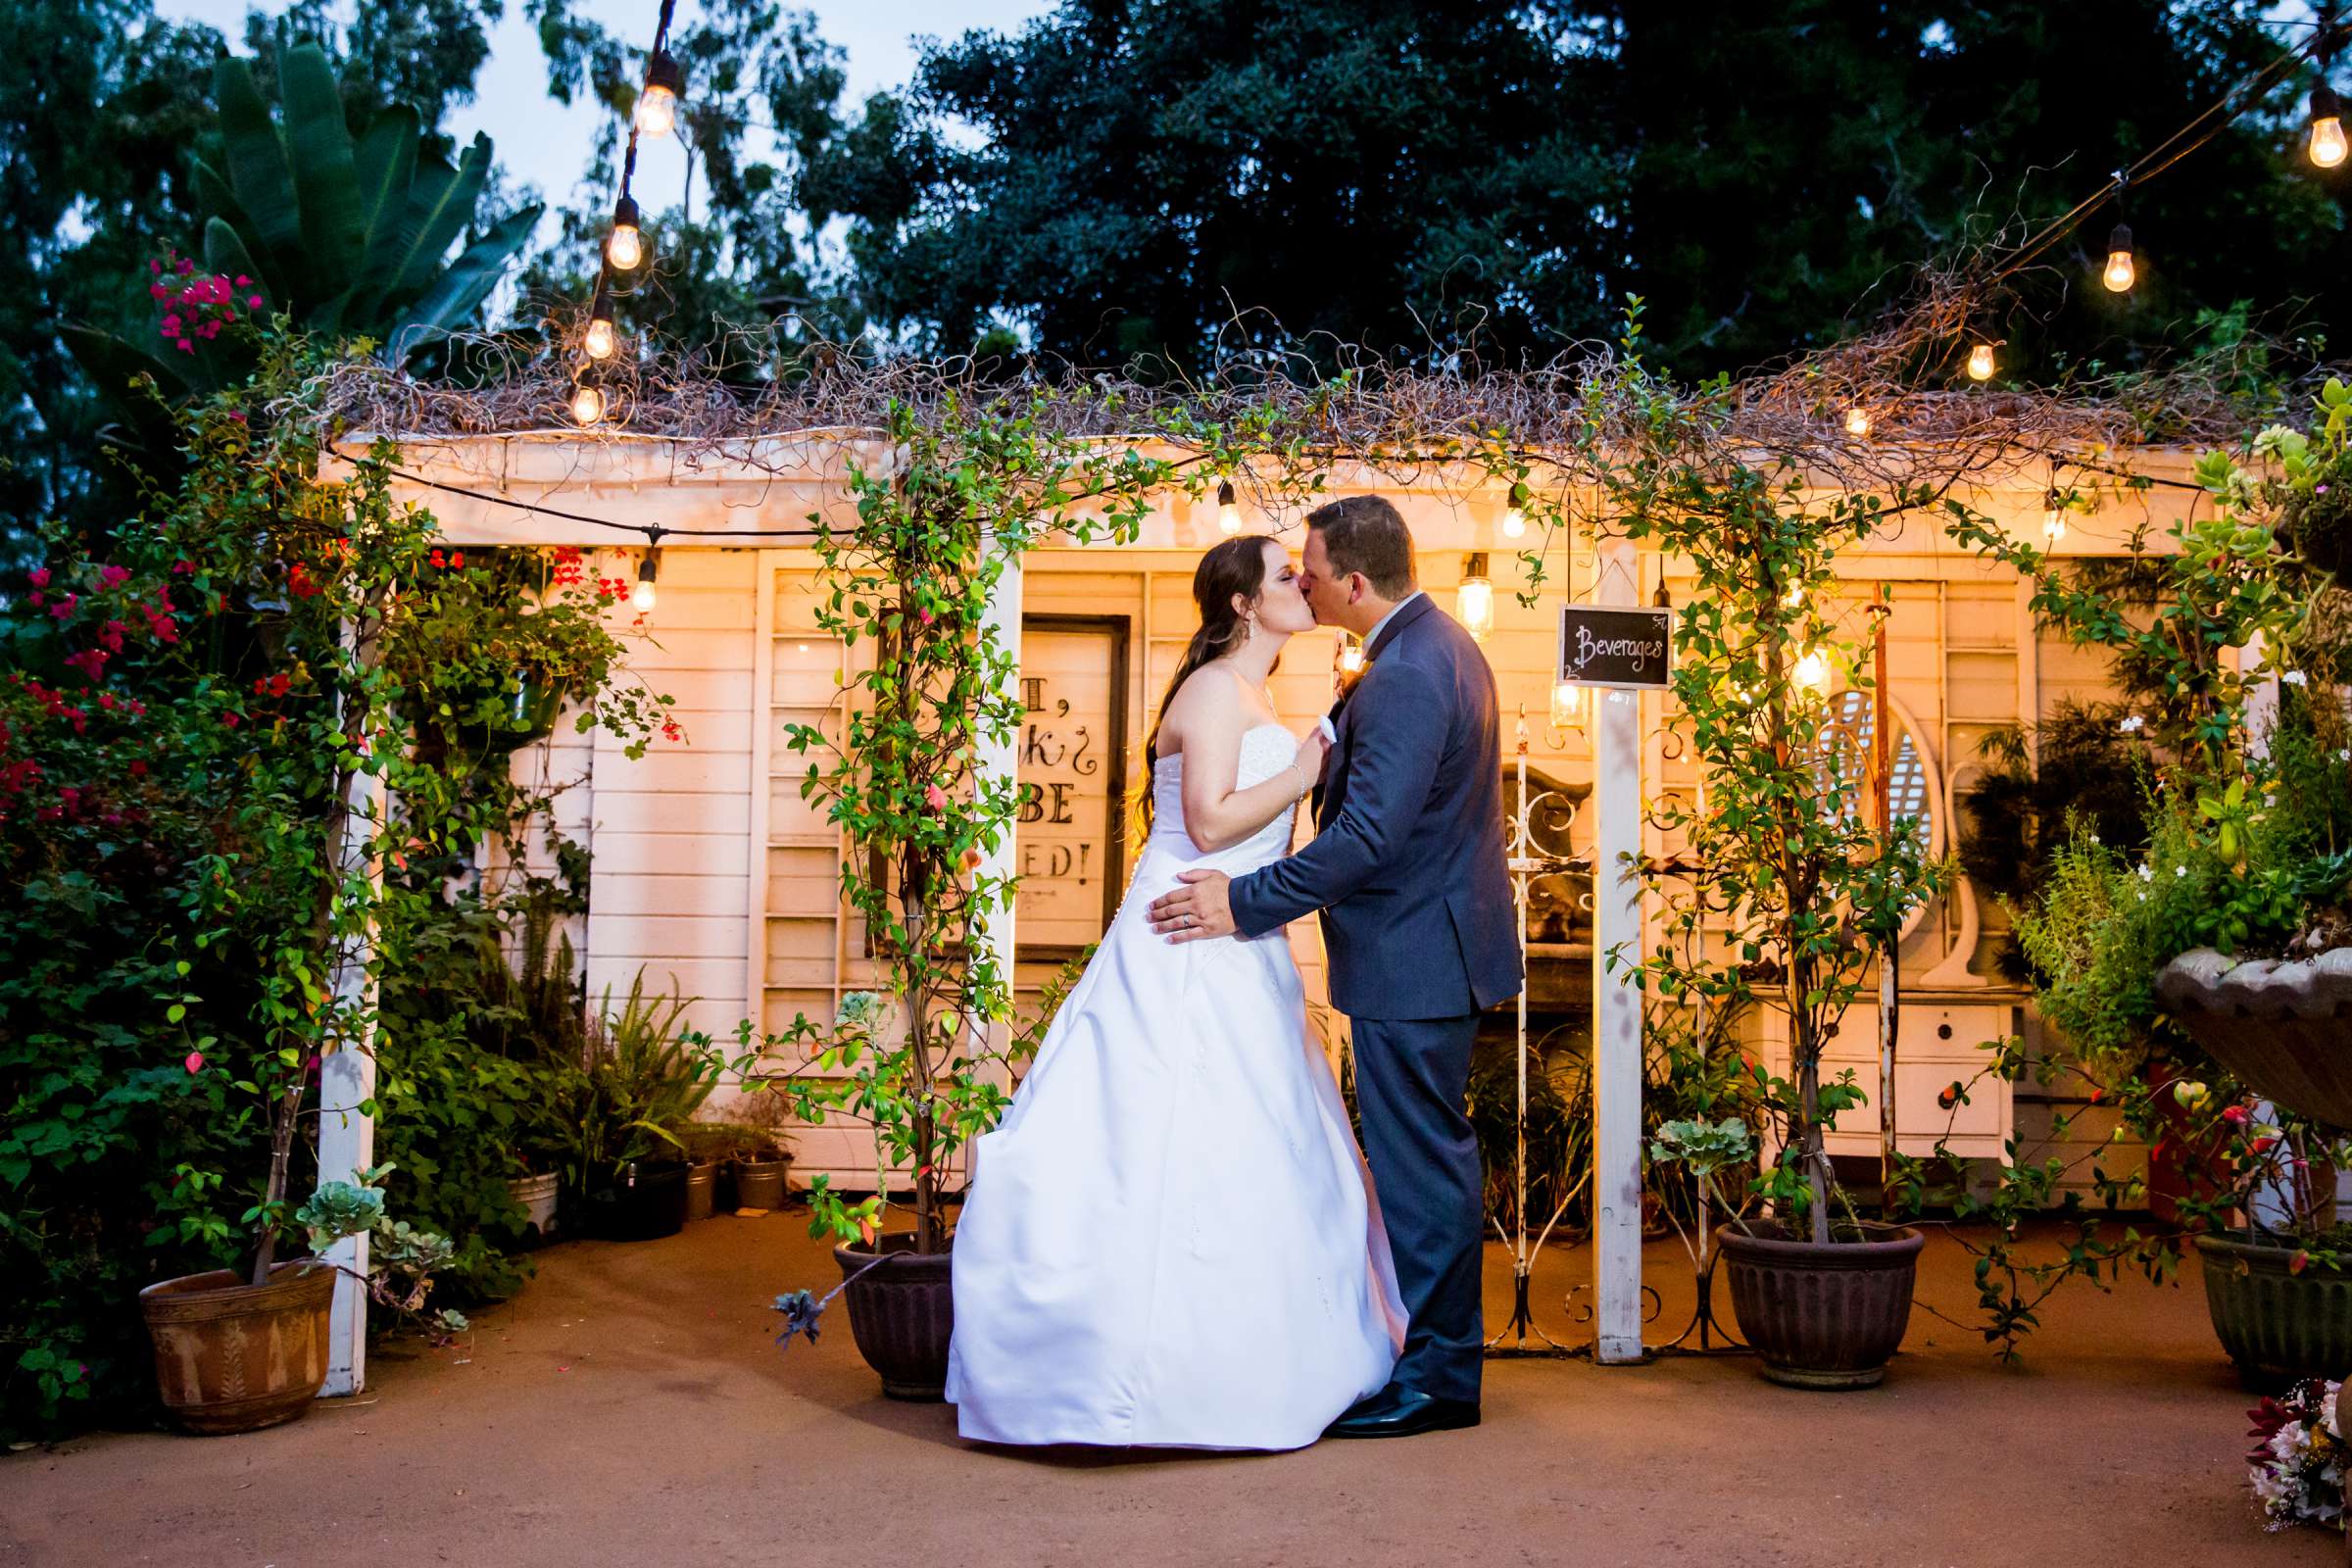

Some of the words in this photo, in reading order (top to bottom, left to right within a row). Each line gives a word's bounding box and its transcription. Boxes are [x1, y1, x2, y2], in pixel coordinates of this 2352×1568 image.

[1574, 625, 1663, 672] Beverages
[1019, 678, 1069, 717] T,
[1016, 782, 1074, 823] BE
[1024, 844, 1090, 886] ED!
